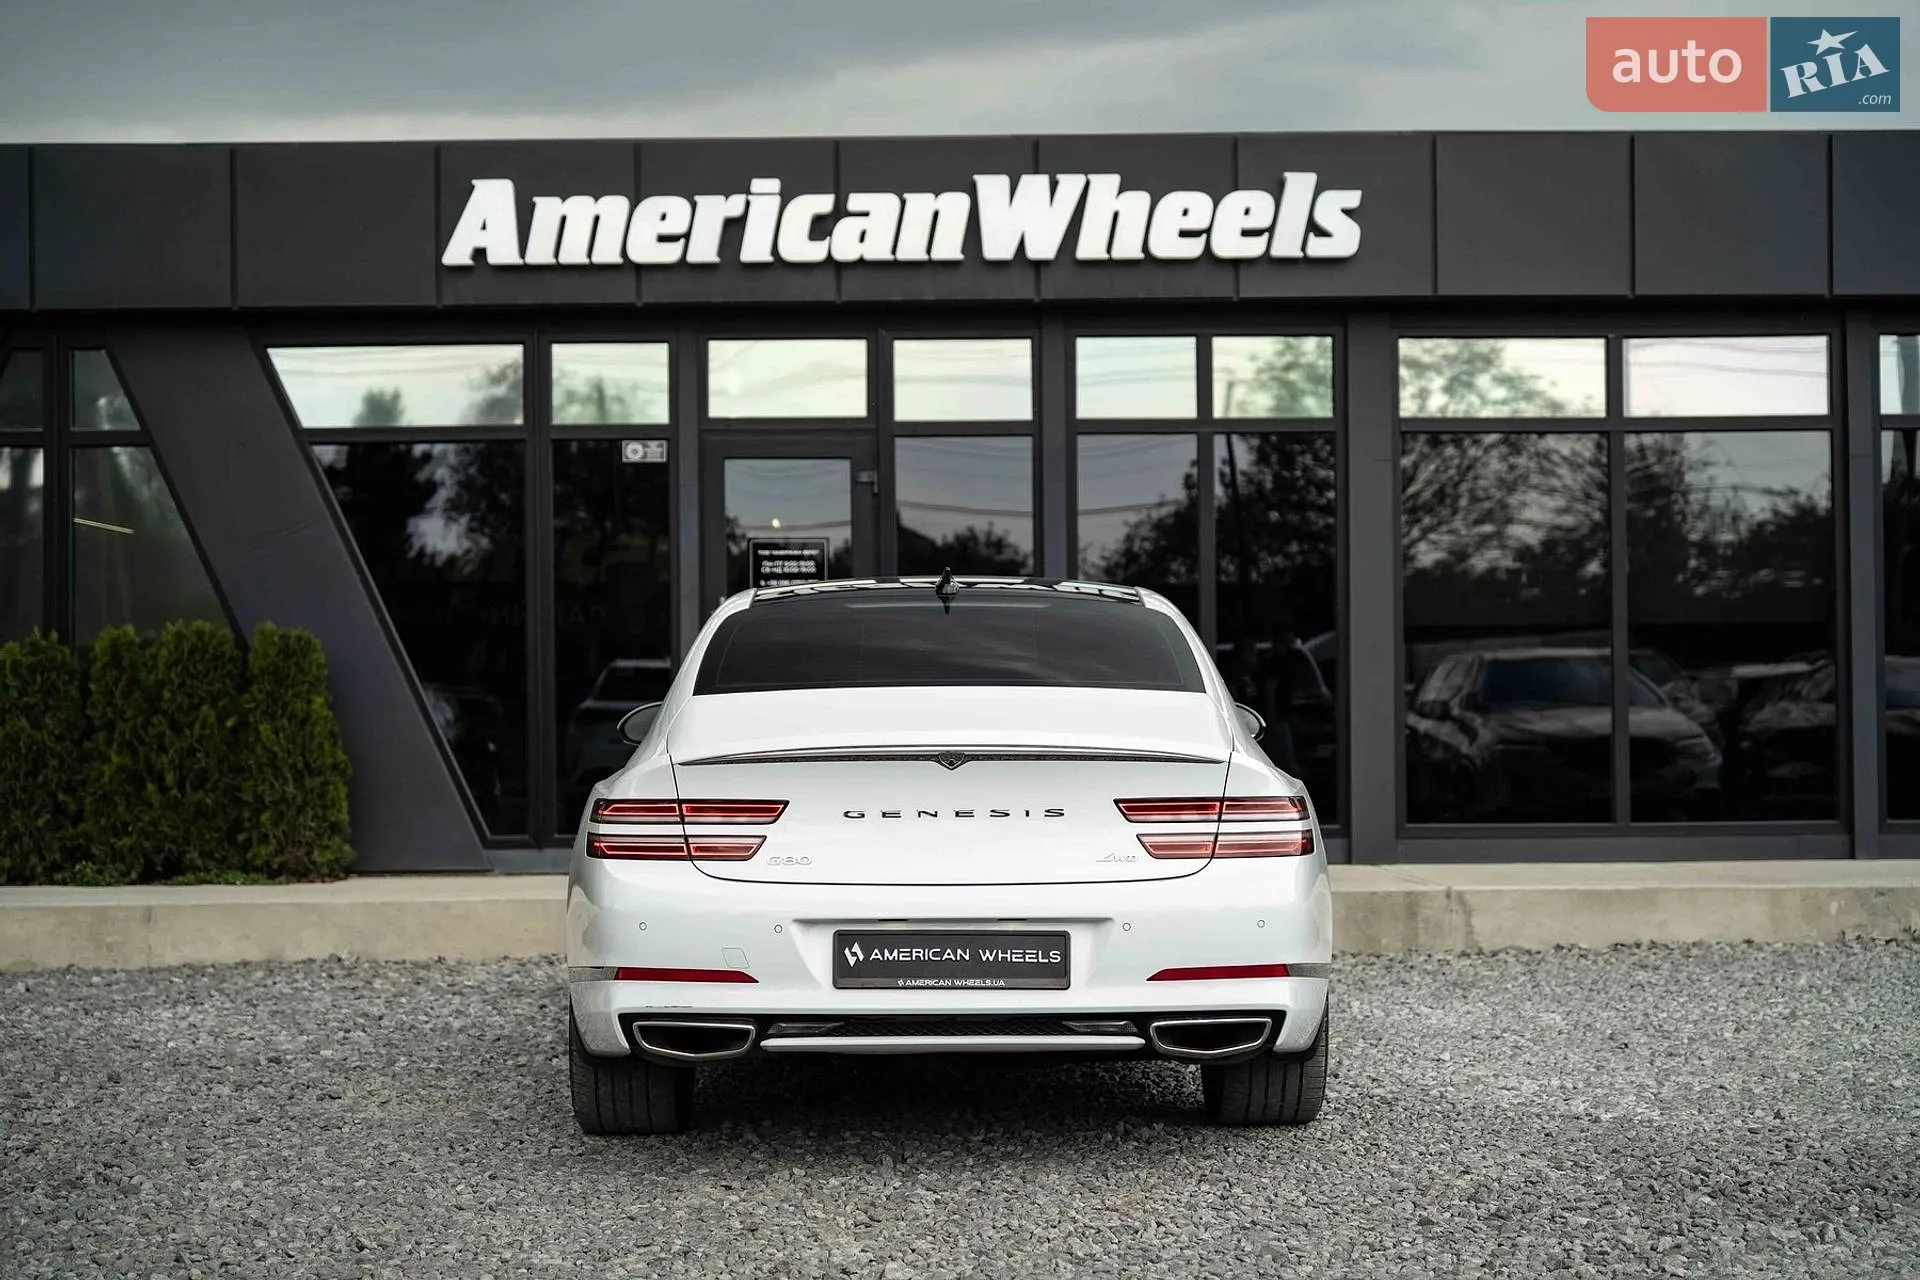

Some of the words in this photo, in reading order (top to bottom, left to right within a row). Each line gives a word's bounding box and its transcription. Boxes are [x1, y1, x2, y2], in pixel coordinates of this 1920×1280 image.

[842, 808, 1066, 819] GENESIS
[766, 855, 813, 866] G80
[869, 948, 970, 961] AMERICAN
[978, 949, 1062, 963] WHEELS
